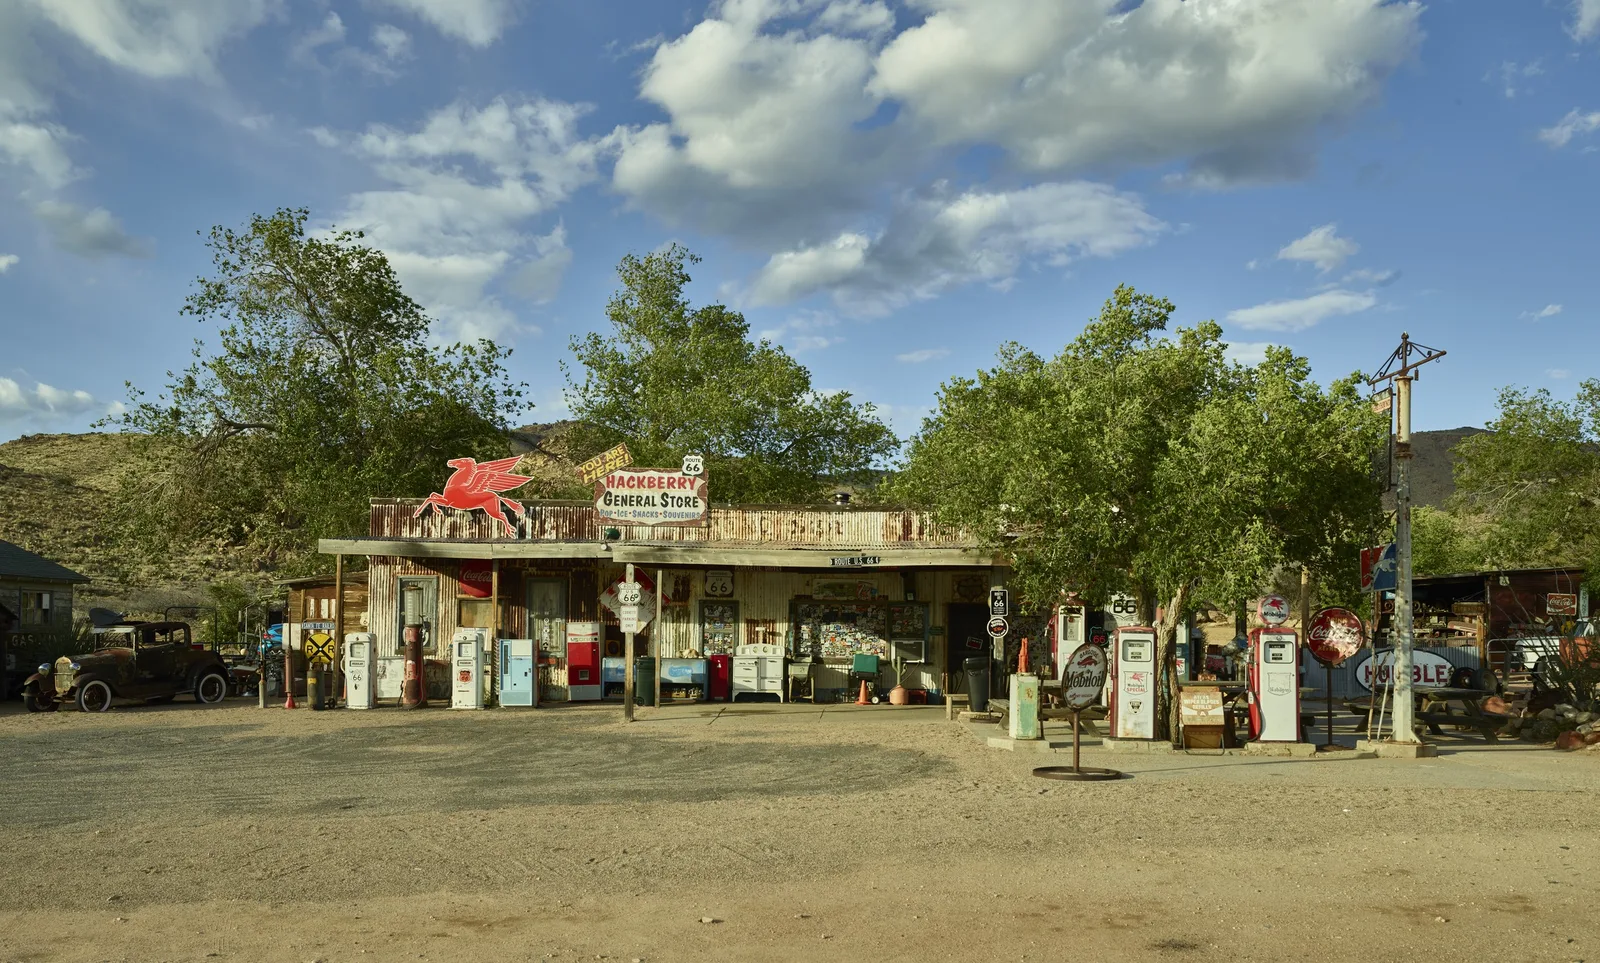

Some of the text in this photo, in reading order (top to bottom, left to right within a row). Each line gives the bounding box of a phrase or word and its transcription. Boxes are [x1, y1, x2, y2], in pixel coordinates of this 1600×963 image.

[581, 446, 625, 474] YOU ARE
[584, 454, 629, 484] HERE!
[685, 464, 700, 472] 66
[606, 475, 697, 490] HACKBERRY
[604, 491, 699, 508] GENERAL STORE
[663, 511, 701, 519] SOUVENIRS
[835, 558, 851, 566] ROUTE
[866, 556, 874, 564] 66
[710, 582, 728, 592] 66
[1113, 600, 1137, 614] 66
[1093, 635, 1105, 643] 66
[306, 645, 314, 653] R
[328, 645, 335, 653] R
[1066, 670, 1105, 688] Mobiloil
[1365, 665, 1448, 683] HUBLE
